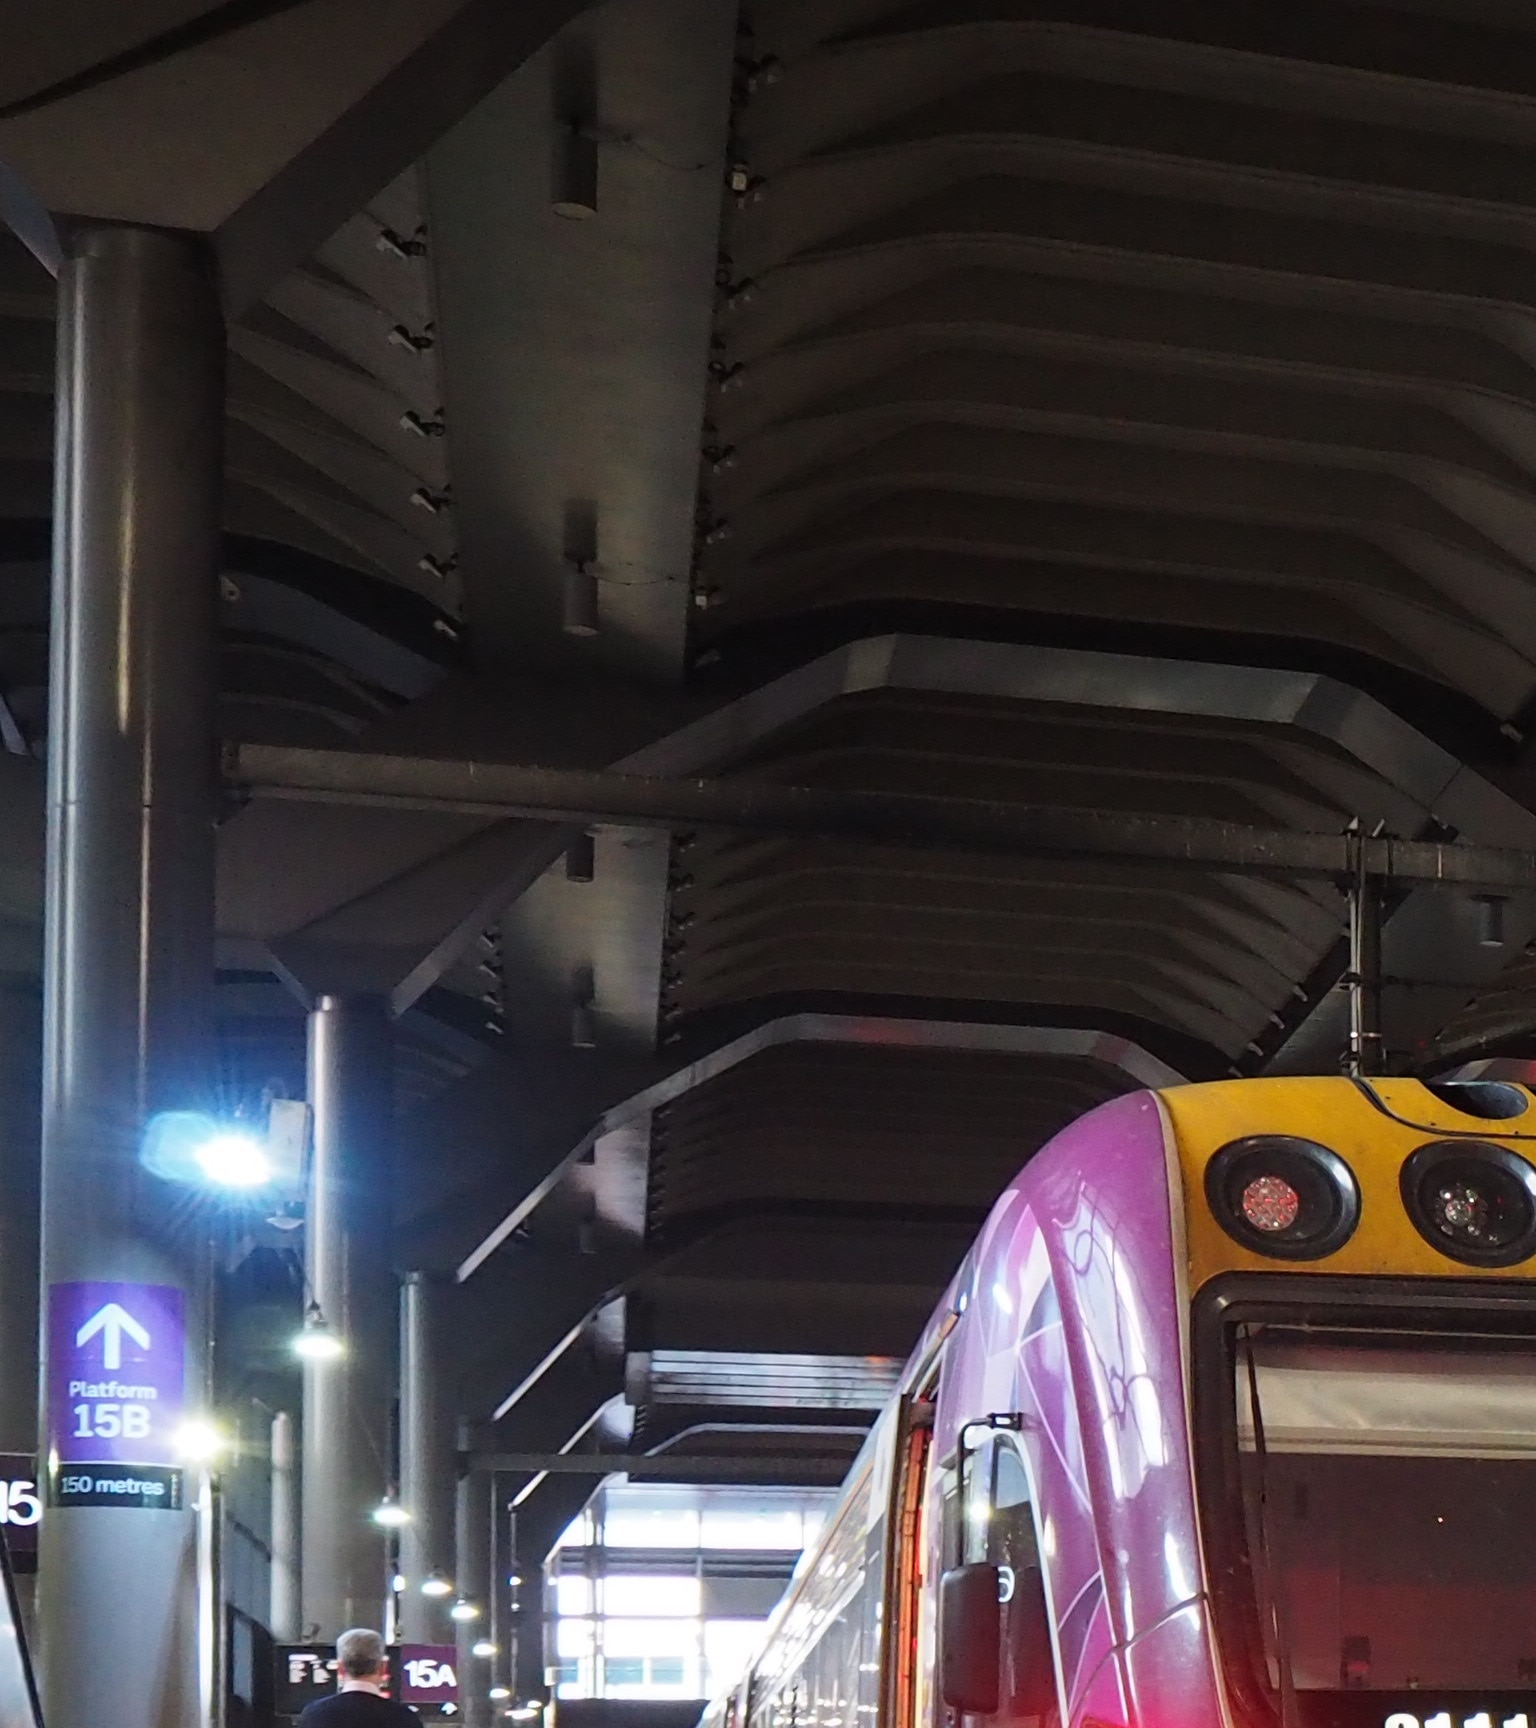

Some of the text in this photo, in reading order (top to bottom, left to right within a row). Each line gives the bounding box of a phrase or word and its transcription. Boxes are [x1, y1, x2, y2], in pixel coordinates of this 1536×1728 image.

[69, 1381, 158, 1399] Platform
[73, 1403, 151, 1438] 15B
[61, 1476, 92, 1494] 150
[95, 1478, 165, 1496] metres
[403, 1659, 457, 1688] 15A
